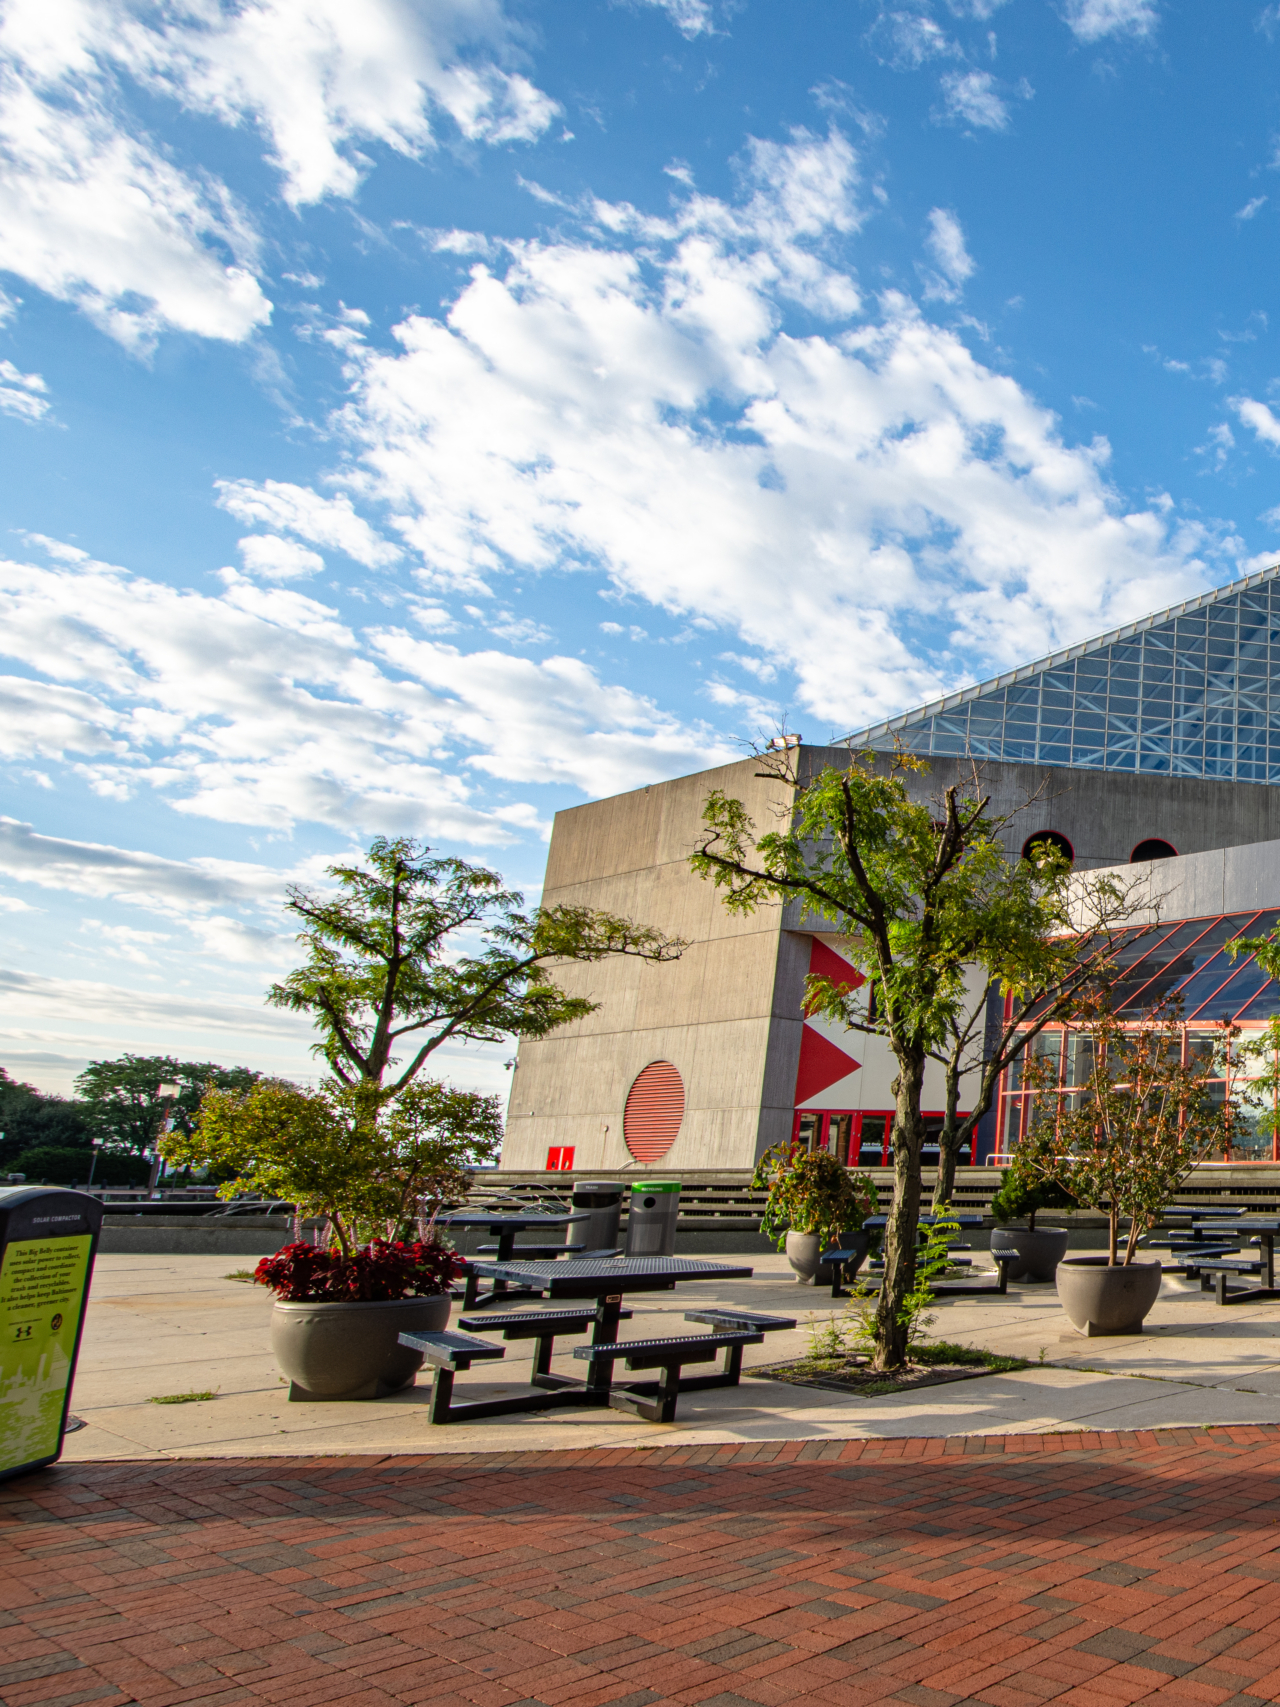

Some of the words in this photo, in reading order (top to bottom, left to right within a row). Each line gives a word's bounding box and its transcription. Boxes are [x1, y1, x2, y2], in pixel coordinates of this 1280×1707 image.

[32, 1216, 50, 1224] SOLAR
[51, 1214, 81, 1222] COMPACTOR
[28, 1248, 39, 1257] Big
[39, 1247, 53, 1255] Belly
[53, 1245, 79, 1253] container
[37, 1257, 55, 1265] power
[11, 1267, 36, 1275] compact
[36, 1264, 48, 1272] and
[48, 1262, 77, 1271] coordinate
[23, 1273, 52, 1282] collection
[51, 1271, 59, 1279] of
[59, 1271, 72, 1279] your
[10, 1285, 27, 1293] trash
[27, 1283, 39, 1291] and
[39, 1280, 71, 1290] recyclables.
[19, 1293, 36, 1301] helps
[36, 1291, 51, 1299] keep
[51, 1287, 78, 1296] Baltimore
[12, 1302, 36, 1311] cleaner,
[36, 1299, 59, 1308] greener
